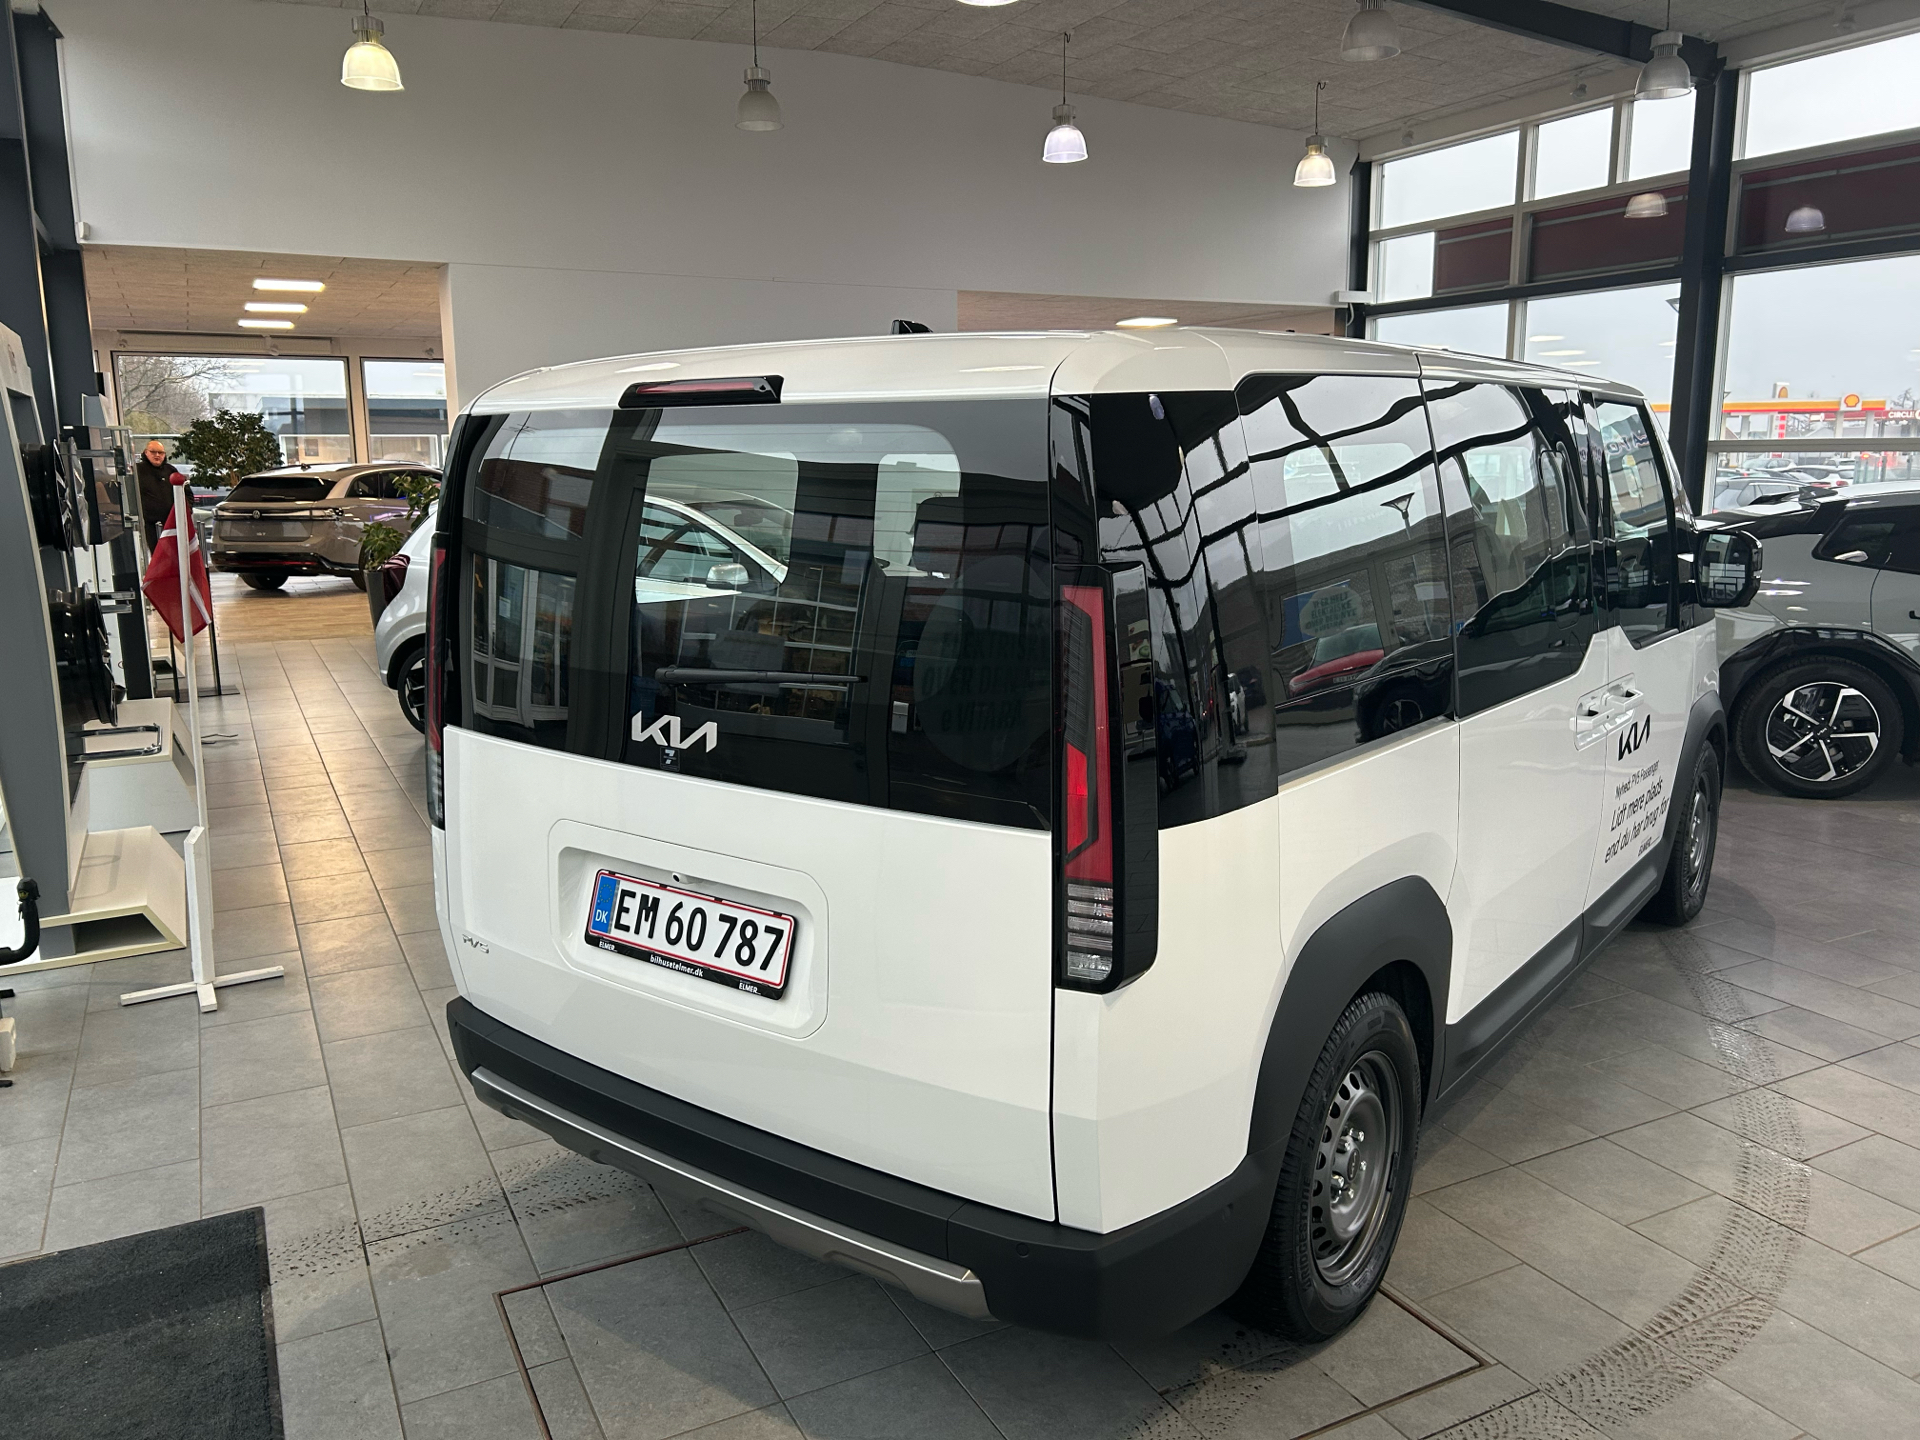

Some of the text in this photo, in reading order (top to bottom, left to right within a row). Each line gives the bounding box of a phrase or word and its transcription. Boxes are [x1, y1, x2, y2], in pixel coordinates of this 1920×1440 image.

[1610, 775, 1663, 832] Lidt mere plads
[1604, 832, 1622, 864] end
[1621, 827, 1632, 850] du
[1630, 820, 1645, 843] har
[1642, 811, 1660, 829] brug
[595, 908, 608, 925] DK
[613, 888, 785, 972] EM 60 787
[599, 940, 616, 950] ELMER
[650, 954, 704, 978] bilhusetelmer.dk
[738, 982, 759, 995] ELMER
